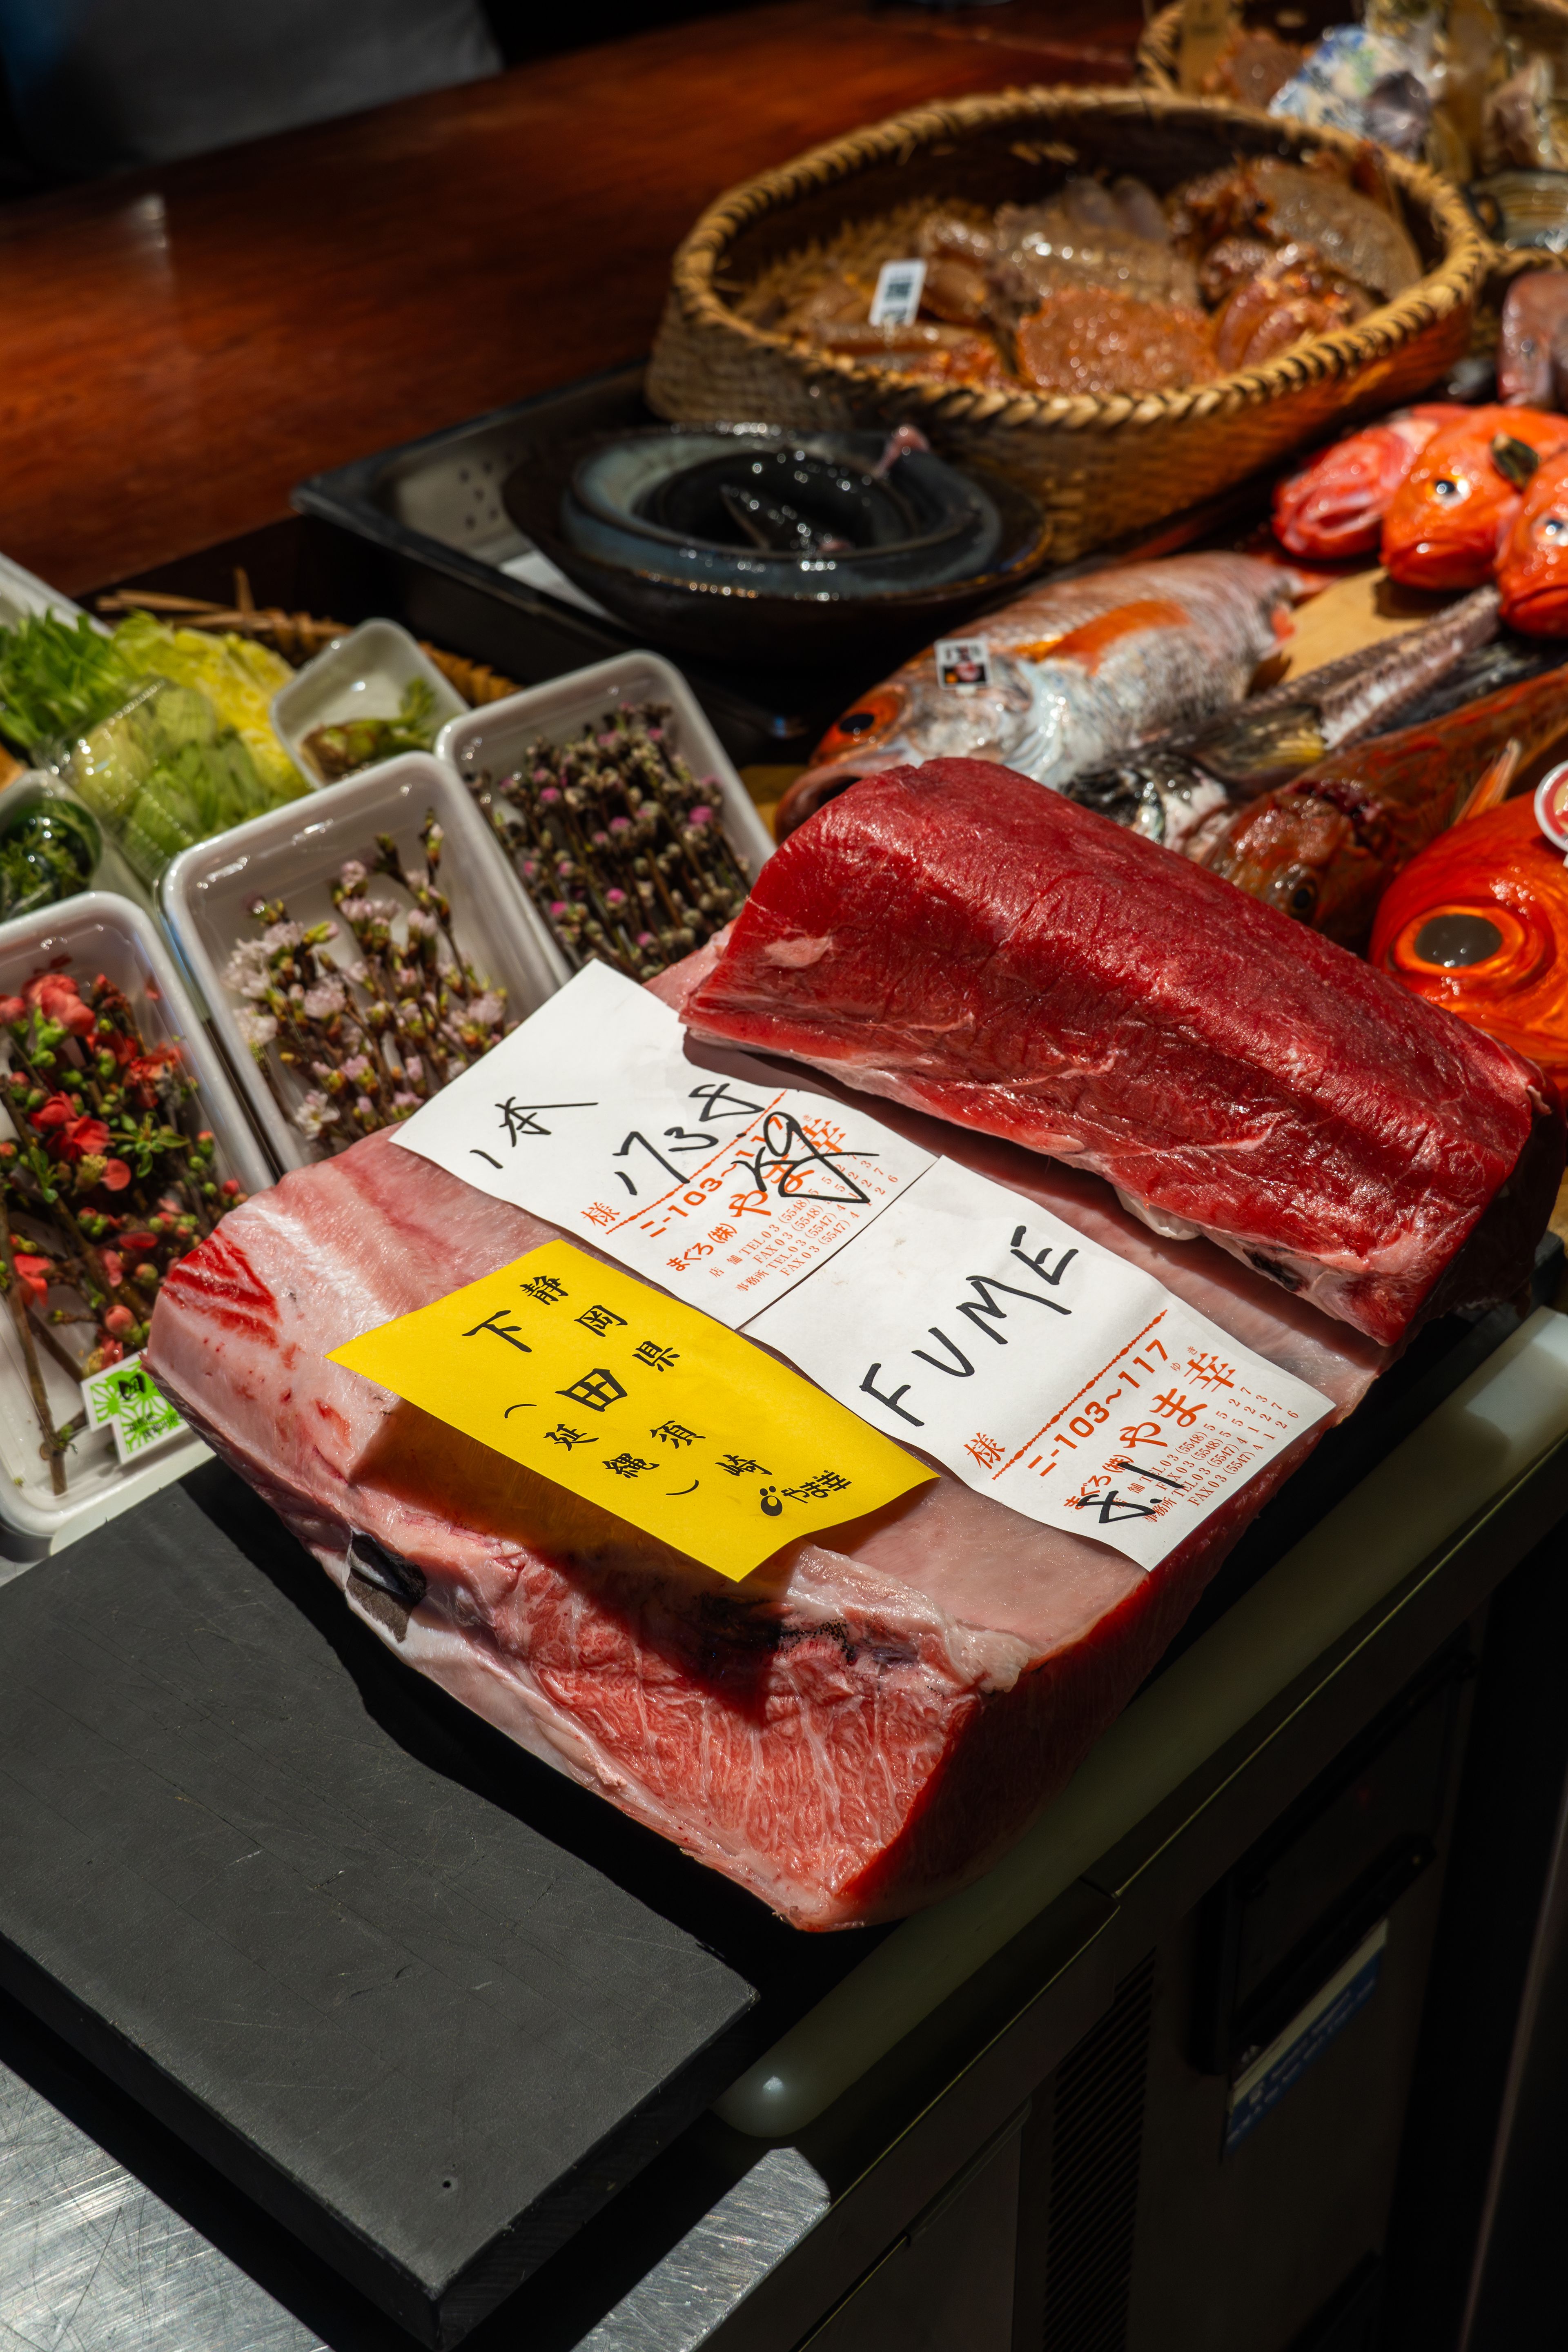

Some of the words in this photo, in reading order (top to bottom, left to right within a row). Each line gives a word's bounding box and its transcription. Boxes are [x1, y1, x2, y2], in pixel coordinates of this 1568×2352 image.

[580, 1201, 620, 1229] 様
[519, 1275, 681, 1372] 静岡県
[859, 1225, 1080, 1427] FUME
[1119, 1353, 1236, 1448] やま幸
[963, 1432, 1005, 1469] 様
[780, 1471, 853, 1504] やま幸
